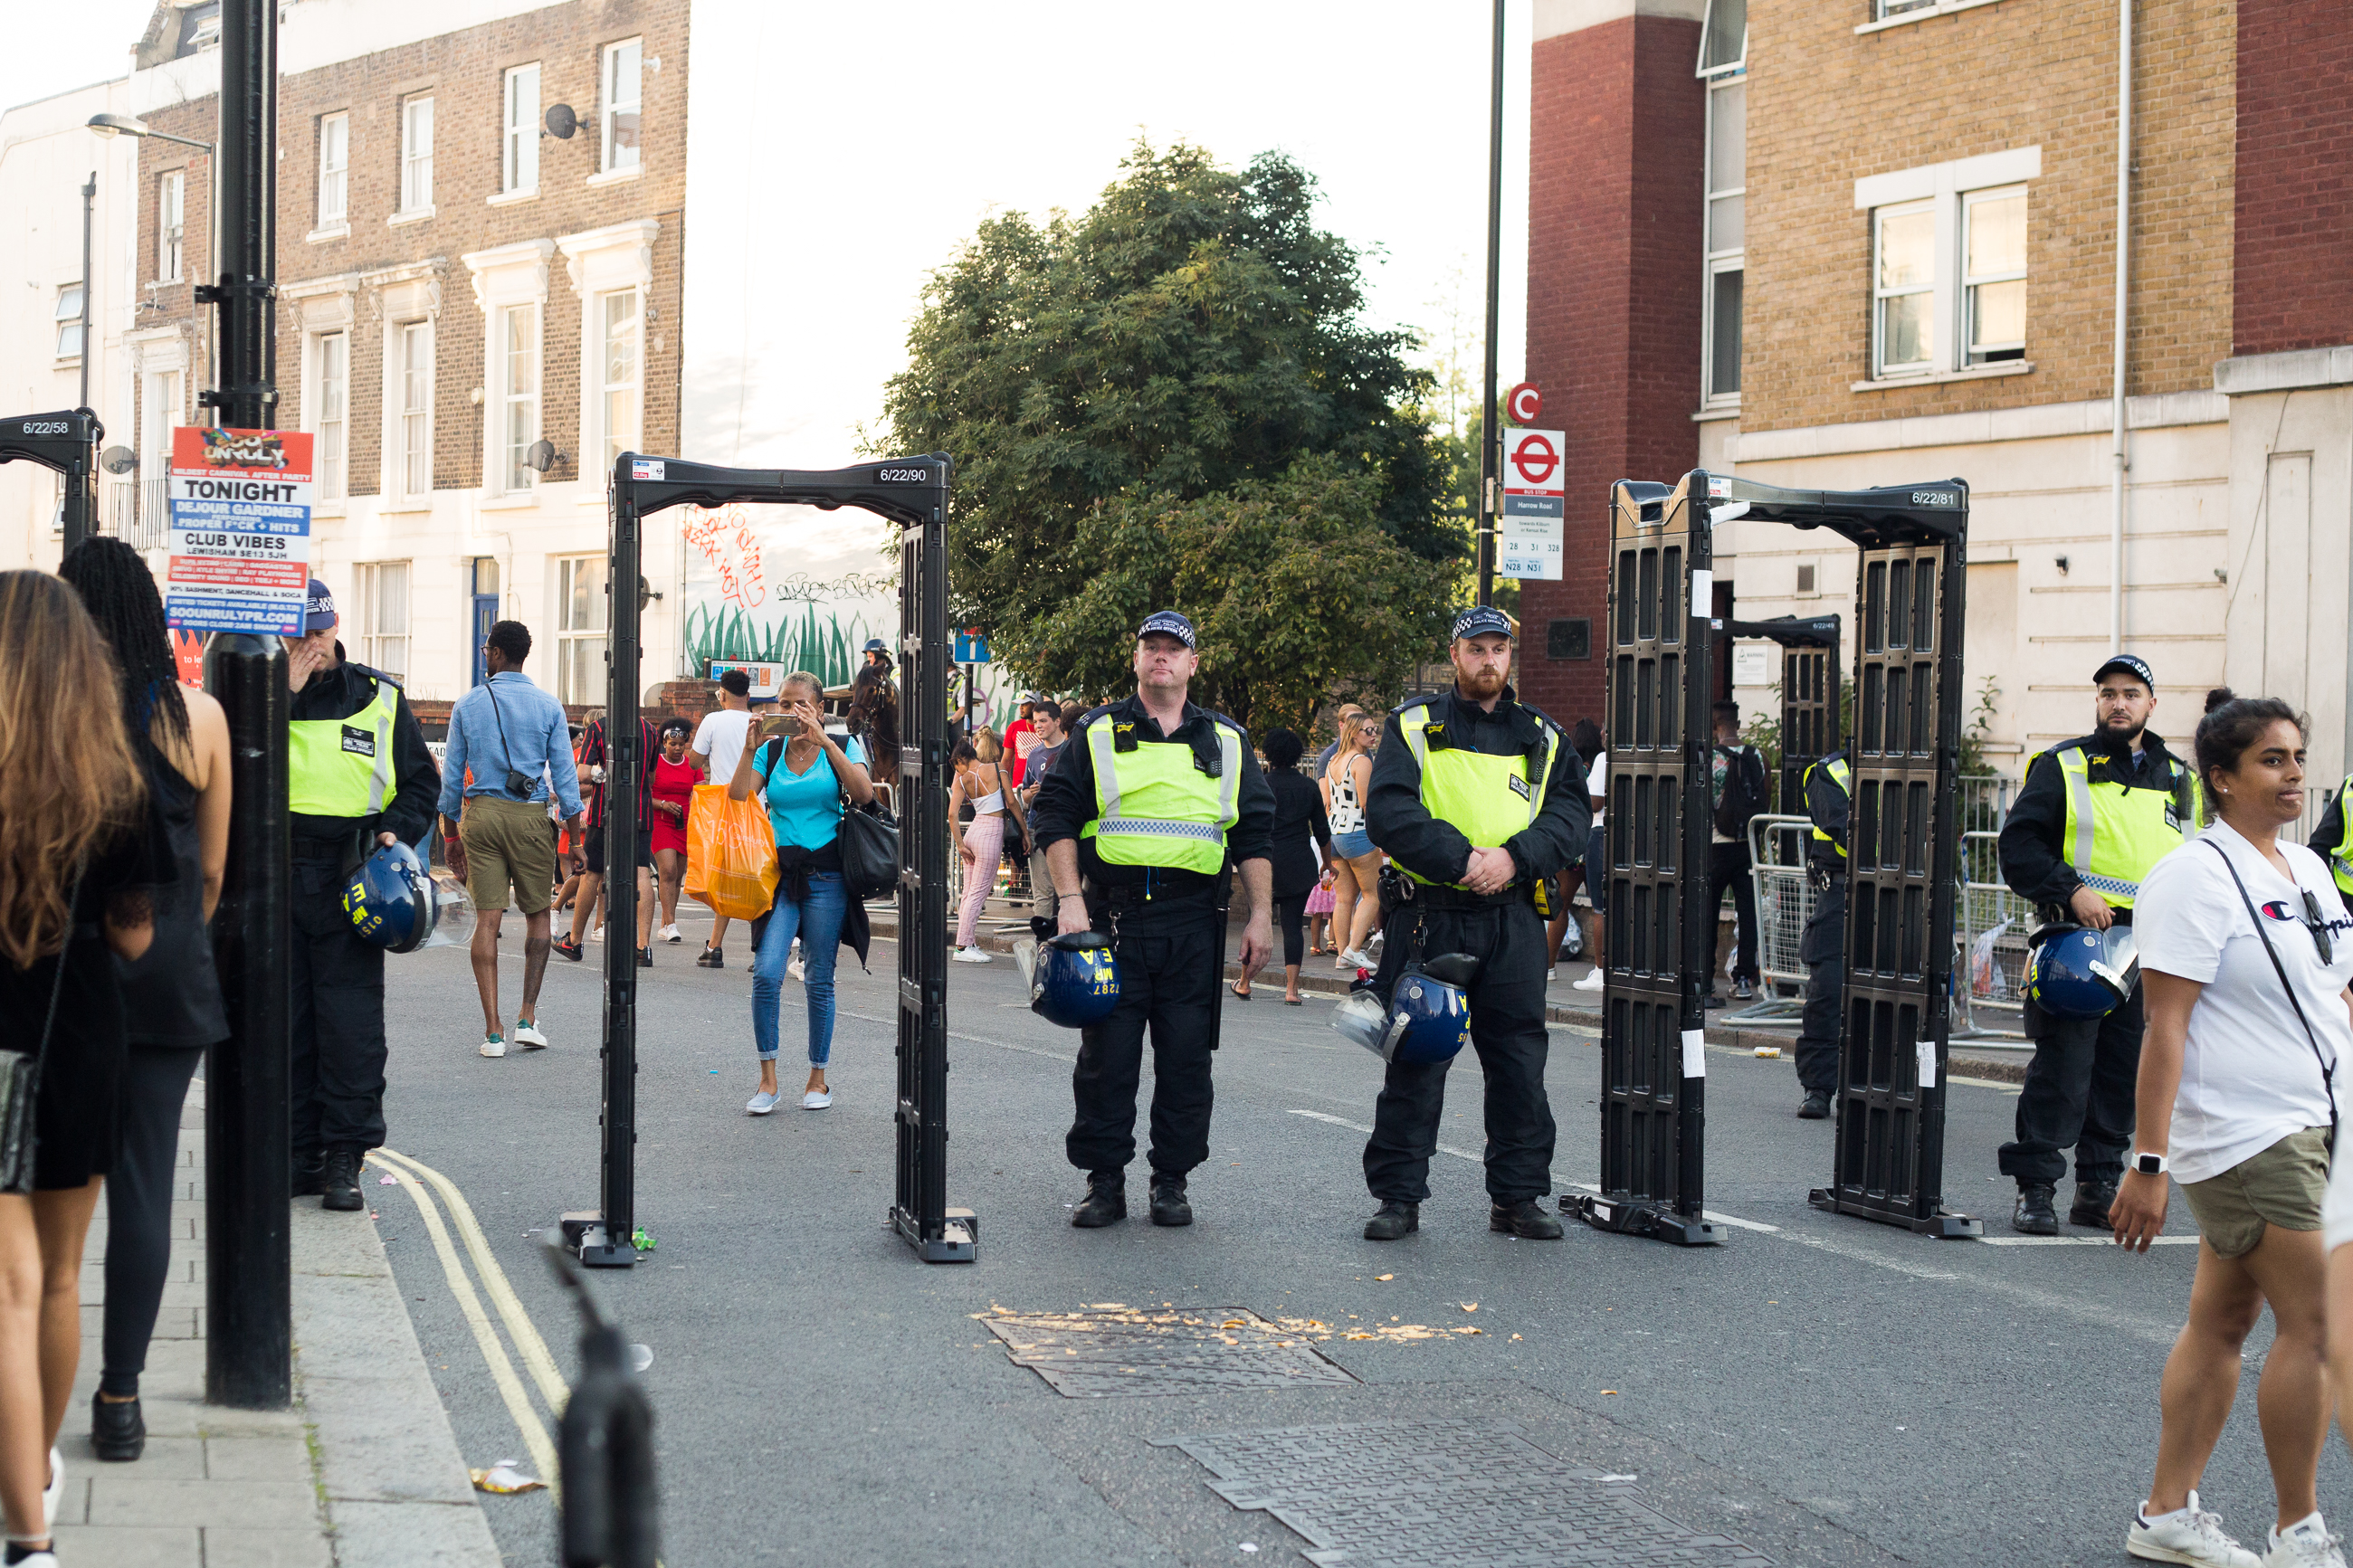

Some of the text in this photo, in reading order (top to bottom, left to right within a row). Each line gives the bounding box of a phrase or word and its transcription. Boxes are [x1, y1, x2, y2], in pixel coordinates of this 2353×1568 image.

[1515, 388, 1538, 420] C
[23, 422, 69, 434] 6/22/58
[204, 445, 285, 461] UNRULY
[173, 468, 311, 481] WILDEST CARNIVAL AFTER PARTY
[881, 469, 926, 480] 6/22/90
[185, 480, 297, 502] TONIGHT
[1912, 492, 1953, 505] 6/22/81
[176, 501, 304, 518] DEJOUR GARDNER
[212, 514, 262, 522] PERFORMING
[178, 518, 223, 528] PROPER
[269, 523, 300, 533] HITS
[186, 533, 285, 550] CLUB VIBES
[1531, 543, 1538, 551] 31
[1548, 544, 1559, 552] 328
[186, 546, 235, 556] LEWISHAM
[268, 551, 287, 559] 5JH
[1506, 563, 1520, 571] N28
[1528, 564, 1540, 572] N31
[226, 601, 267, 609] AVAILABLE
[169, 606, 298, 623] SOOUNRULYPR.COM
[183, 619, 208, 627] DOORS
[1813, 622, 1835, 630] 6/22/49
[708, 819, 742, 849] 150
[1094, 967, 1113, 982] MP
